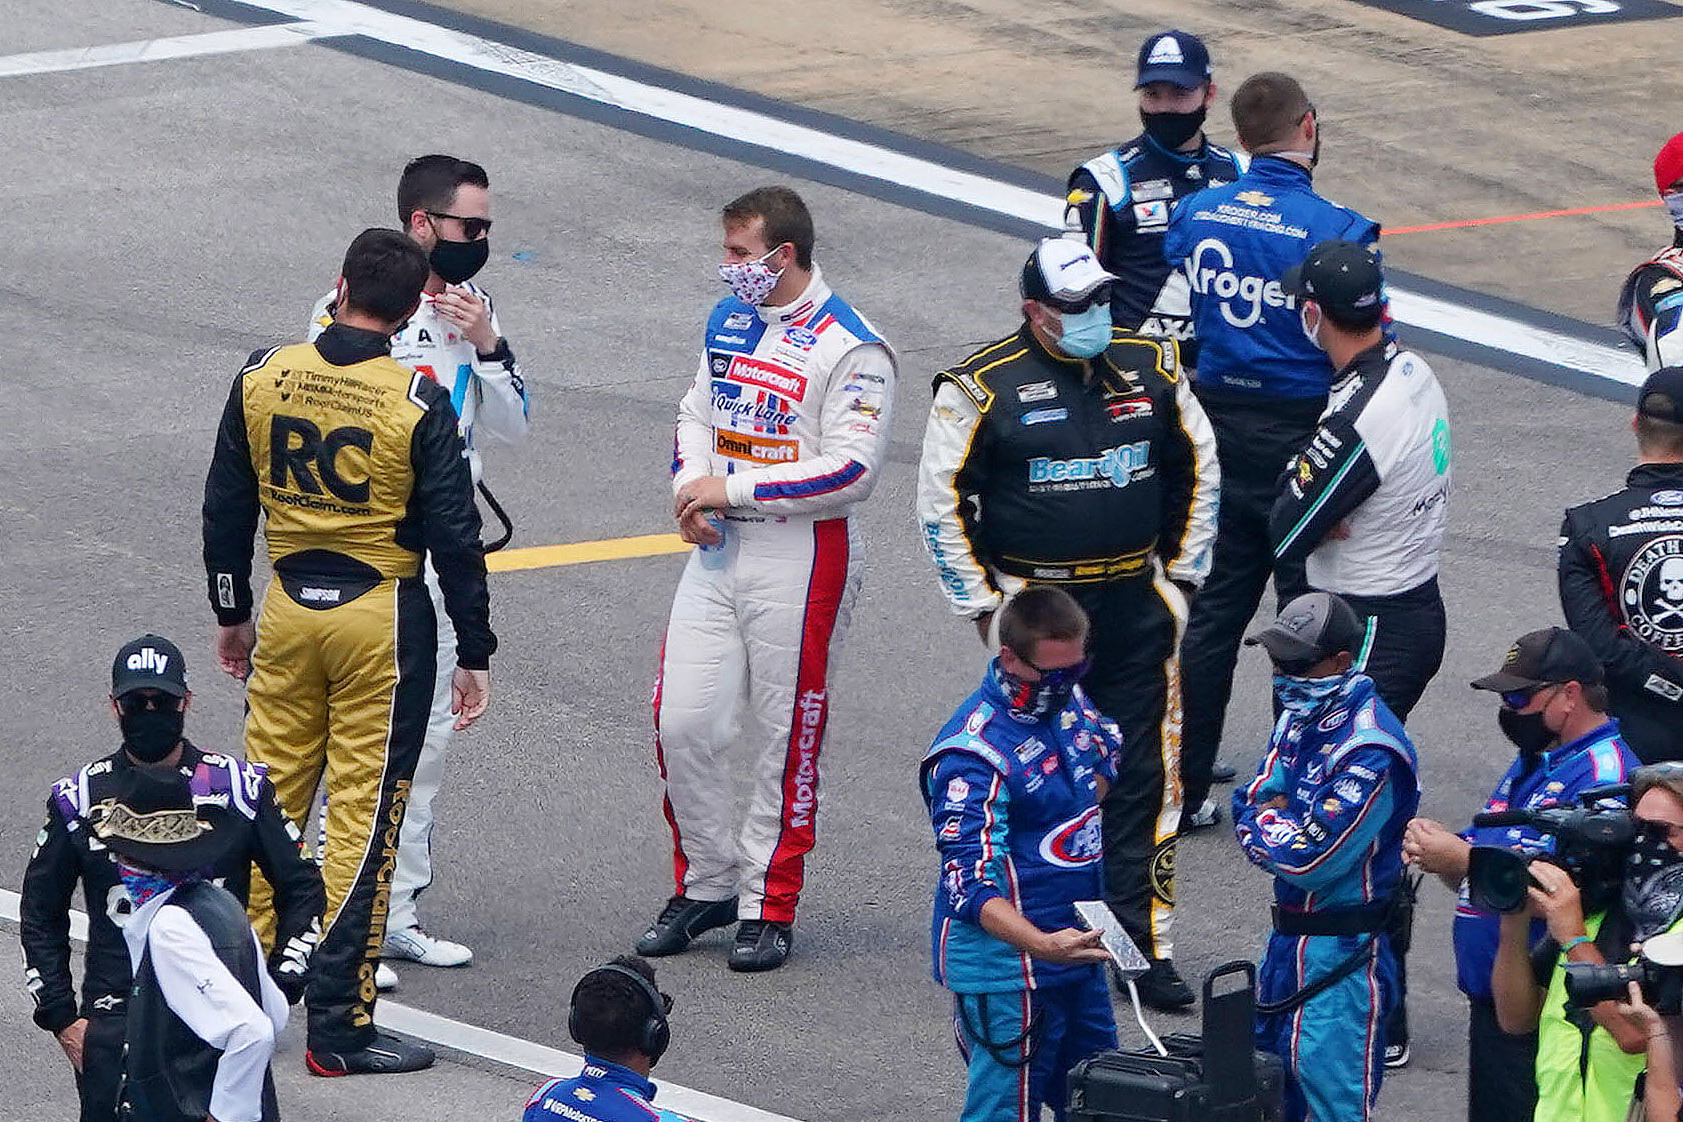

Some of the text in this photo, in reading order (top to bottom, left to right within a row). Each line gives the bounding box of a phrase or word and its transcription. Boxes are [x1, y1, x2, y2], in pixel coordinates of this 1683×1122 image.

[732, 362, 802, 395] Motorcraft
[716, 394, 797, 425] Quick Lane
[269, 414, 374, 503] RC
[717, 434, 795, 461] Omnicraft
[1027, 449, 1115, 483] Beard
[271, 490, 371, 515] RoofClaim.com
[1628, 540, 1681, 582] DEATH
[127, 648, 167, 675] ally
[791, 689, 827, 827] Motorcraft
